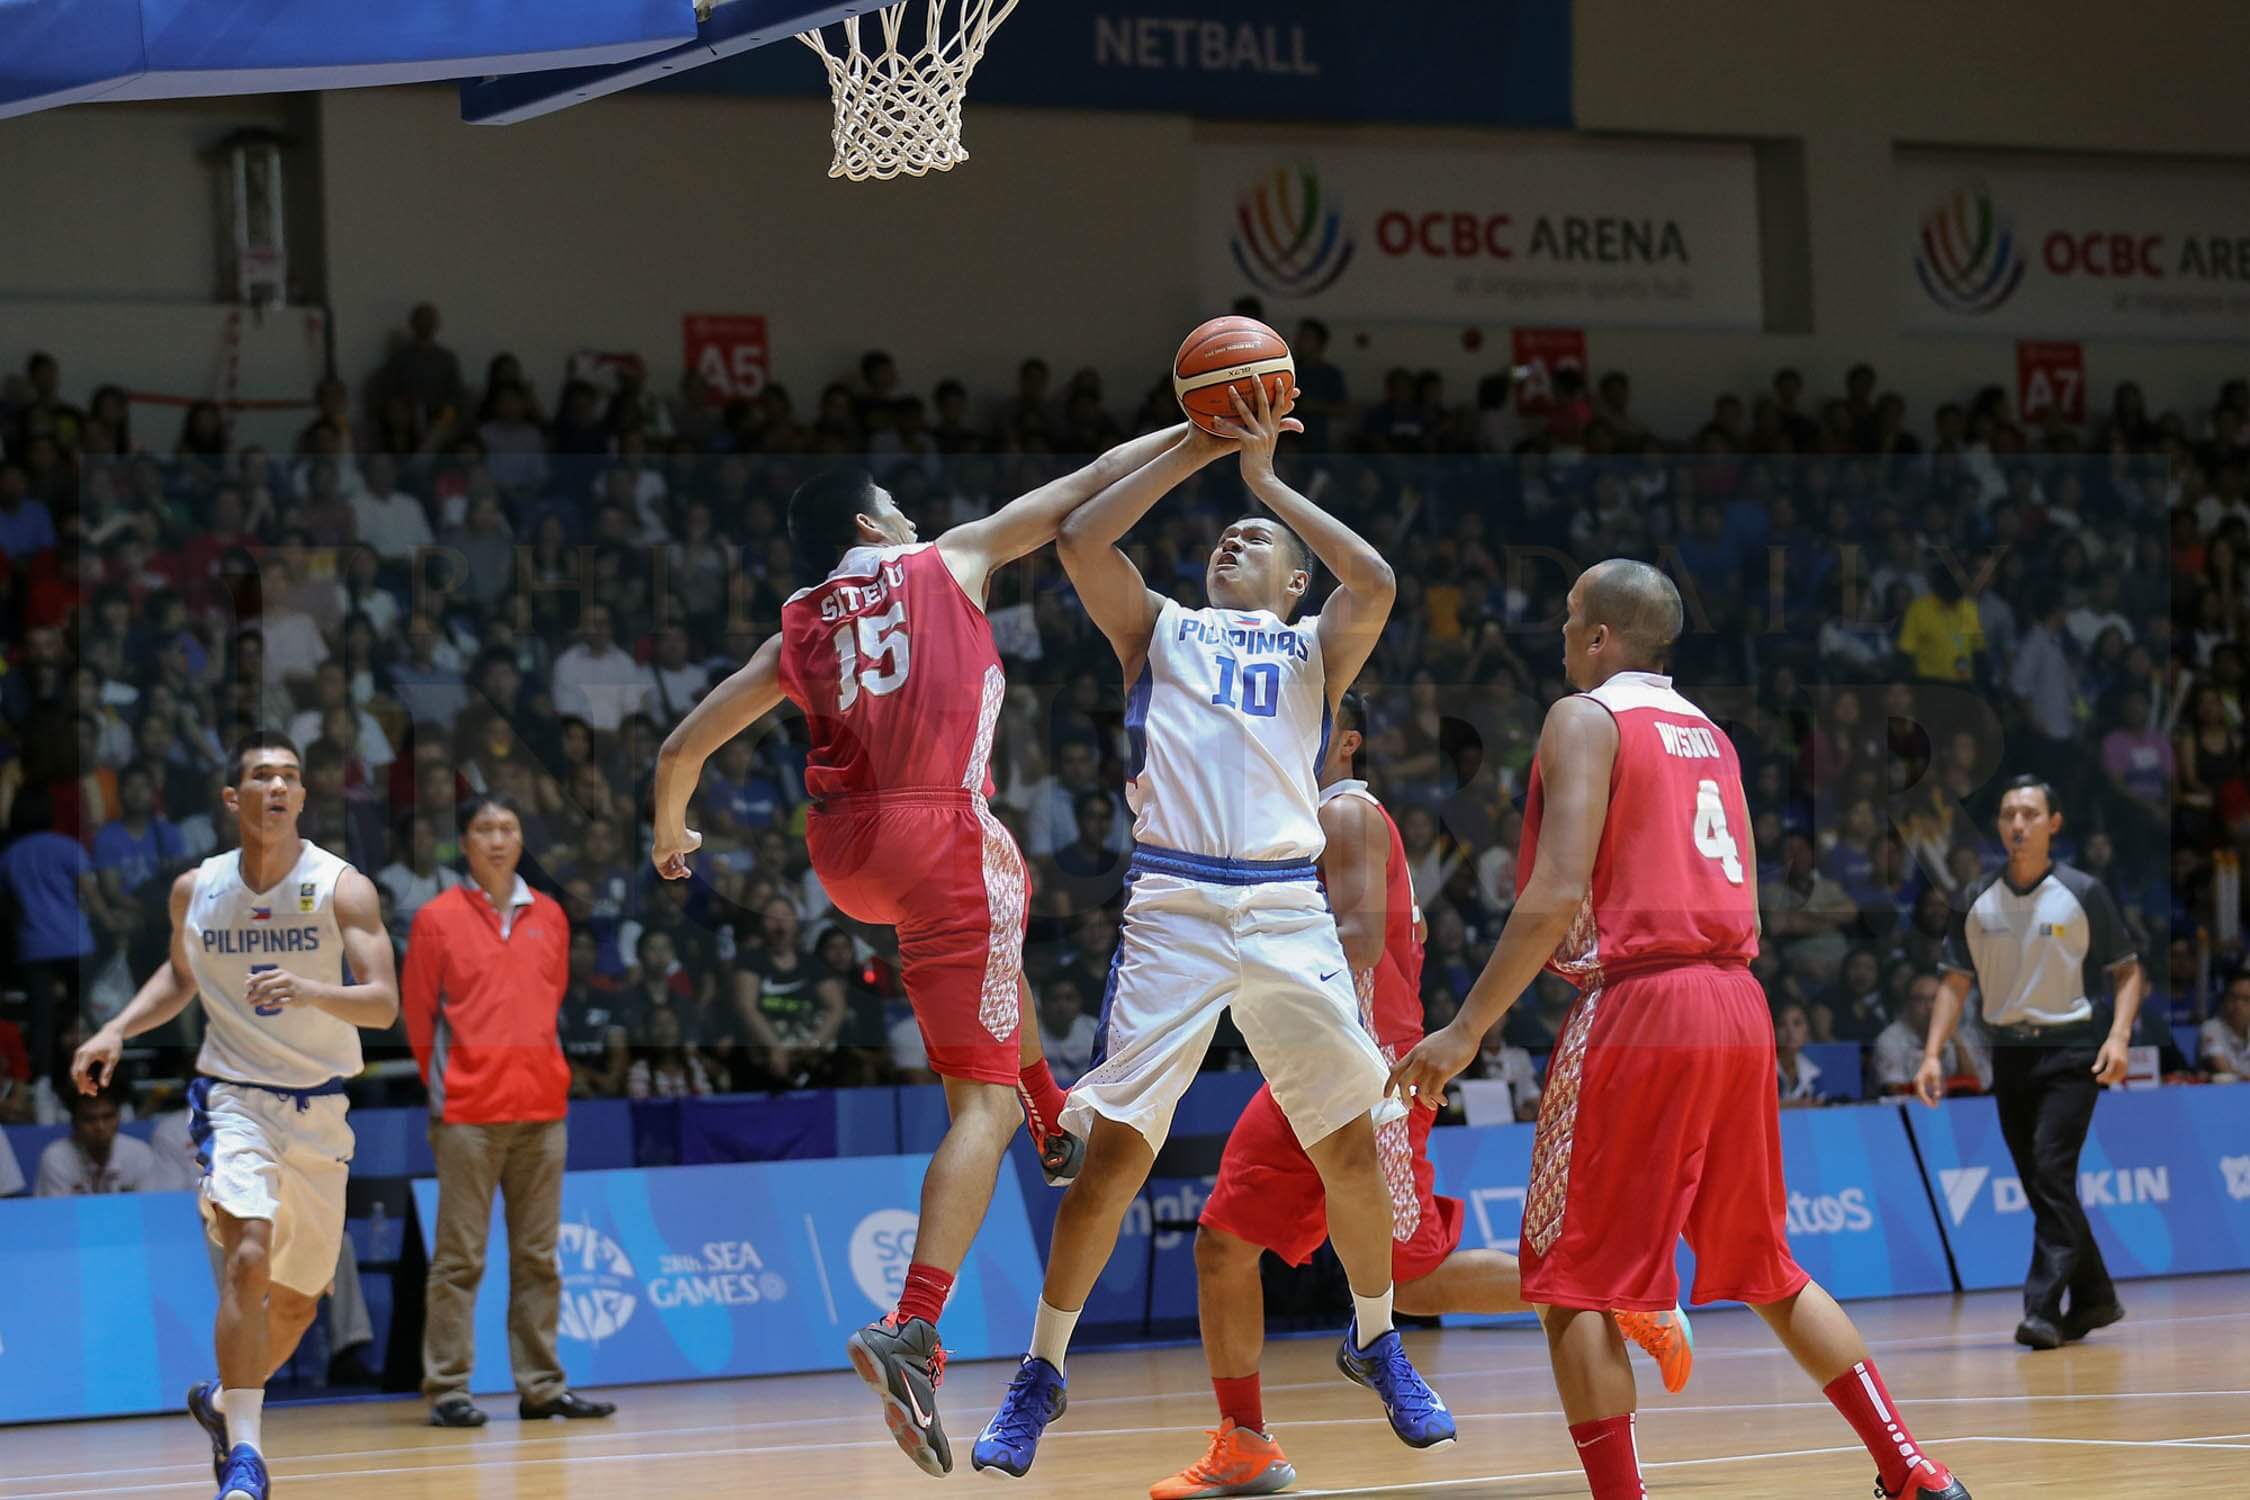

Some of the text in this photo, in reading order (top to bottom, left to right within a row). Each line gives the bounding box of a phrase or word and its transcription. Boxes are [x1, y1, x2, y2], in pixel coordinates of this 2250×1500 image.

[1094, 15, 1320, 79] NETBALL
[1376, 210, 1688, 264] OCBC ARENA
[2043, 230, 2164, 278] OCBC
[699, 344, 764, 398] A5
[2024, 367, 2080, 416] A7
[833, 601, 911, 713] 15
[1211, 654, 1280, 718] 10
[1693, 779, 1744, 884] 4
[202, 926, 320, 954] PILIPINAS
[1991, 1165, 2171, 1214] DKIN
[703, 1240, 763, 1270] SEA
[648, 1273, 760, 1307] GAMES
